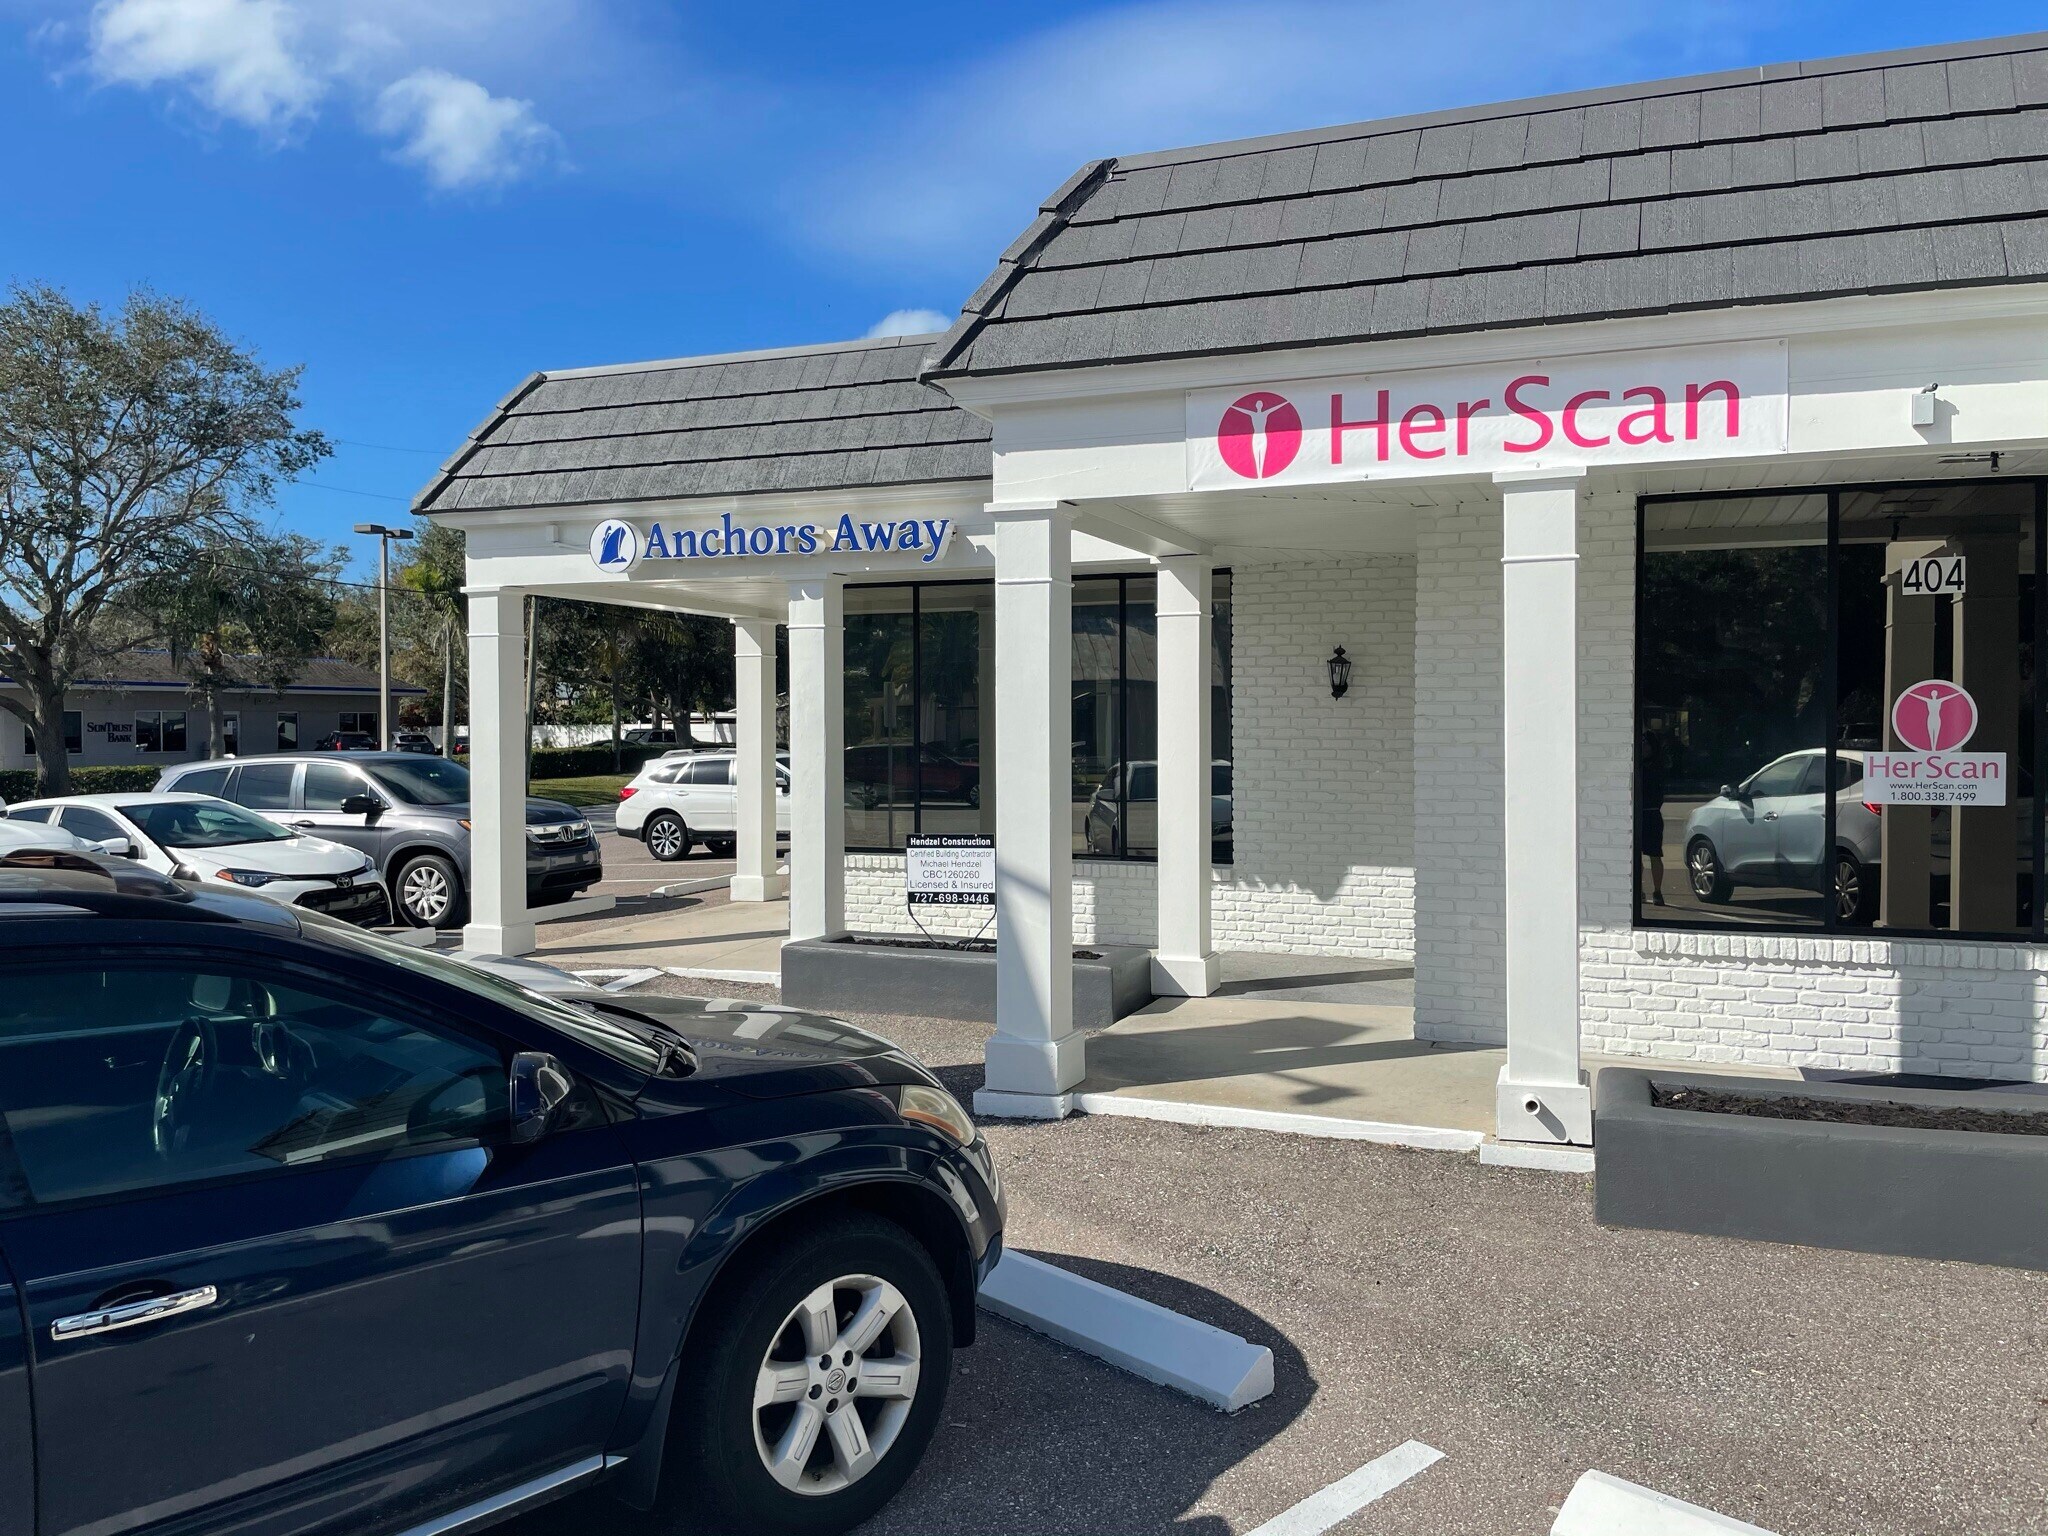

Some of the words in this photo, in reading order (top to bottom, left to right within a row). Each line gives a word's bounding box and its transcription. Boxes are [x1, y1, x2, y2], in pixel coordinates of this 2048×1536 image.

[1330, 375, 1740, 465] HerScan
[643, 512, 817, 560] Anchors
[830, 512, 950, 564] Away
[1903, 558, 1965, 593] 404
[1868, 755, 1999, 779] HerScan
[1889, 781, 1978, 790] www.HerScan.com
[1890, 791, 1977, 801] 1.800.338.7499
[910, 837, 940, 846] Hendzel
[942, 837, 991, 846] Construction
[910, 850, 935, 858] Certified
[935, 850, 959, 859] Building
[960, 850, 992, 858] Contractor
[920, 860, 949, 868] Michael
[951, 860, 982, 868] Hendzel
[922, 870, 980, 879] CBC1260260
[909, 880, 949, 889] Licensed
[951, 880, 958, 889] &
[960, 880, 994, 890] Insured
[914, 893, 990, 904] 727-698-9446
